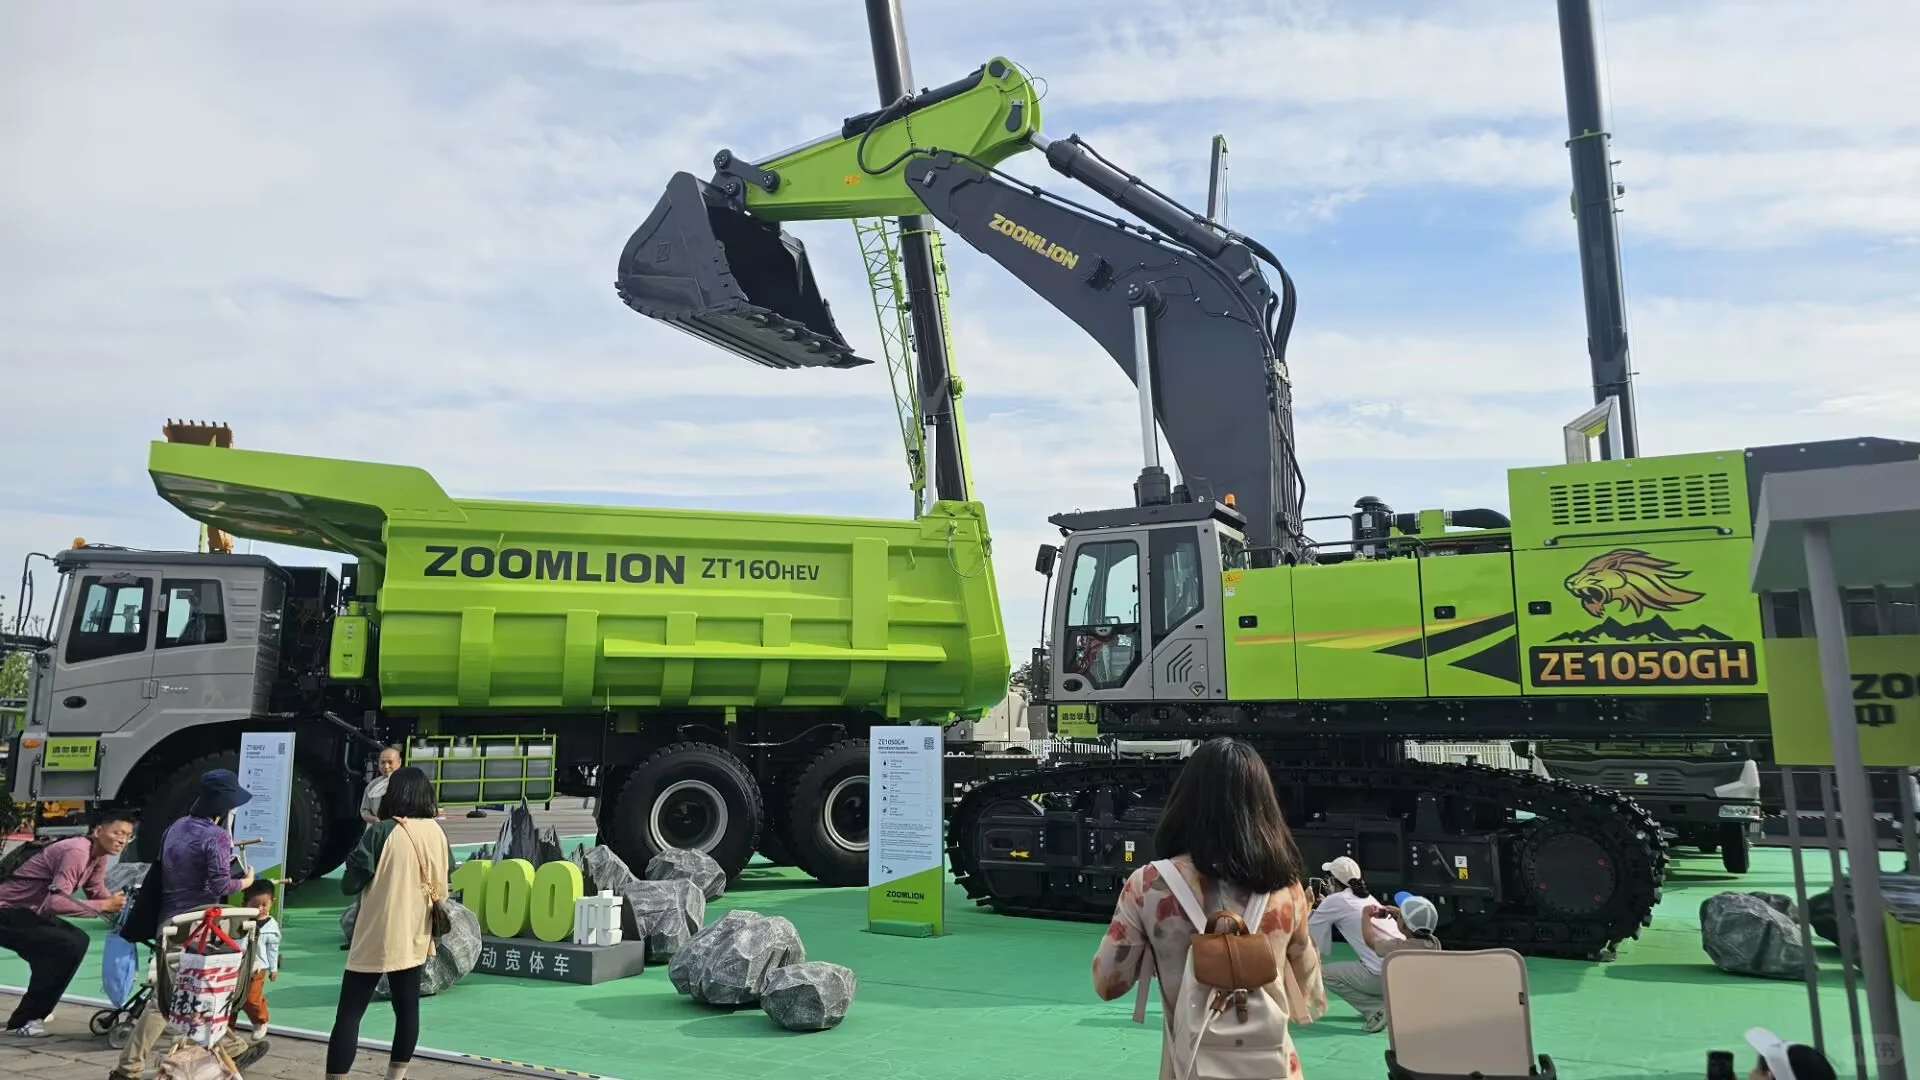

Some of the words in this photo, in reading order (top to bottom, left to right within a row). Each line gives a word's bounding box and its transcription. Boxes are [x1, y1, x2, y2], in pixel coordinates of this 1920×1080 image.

[988, 213, 1079, 270] ZOOMLION
[424, 545, 685, 584] ZOOMLION
[701, 557, 820, 581] ZT160HEV
[1538, 648, 1749, 681] ZE1050GH
[1850, 672, 1920, 700] ZO
[886, 890, 925, 900] ZOOMLION
